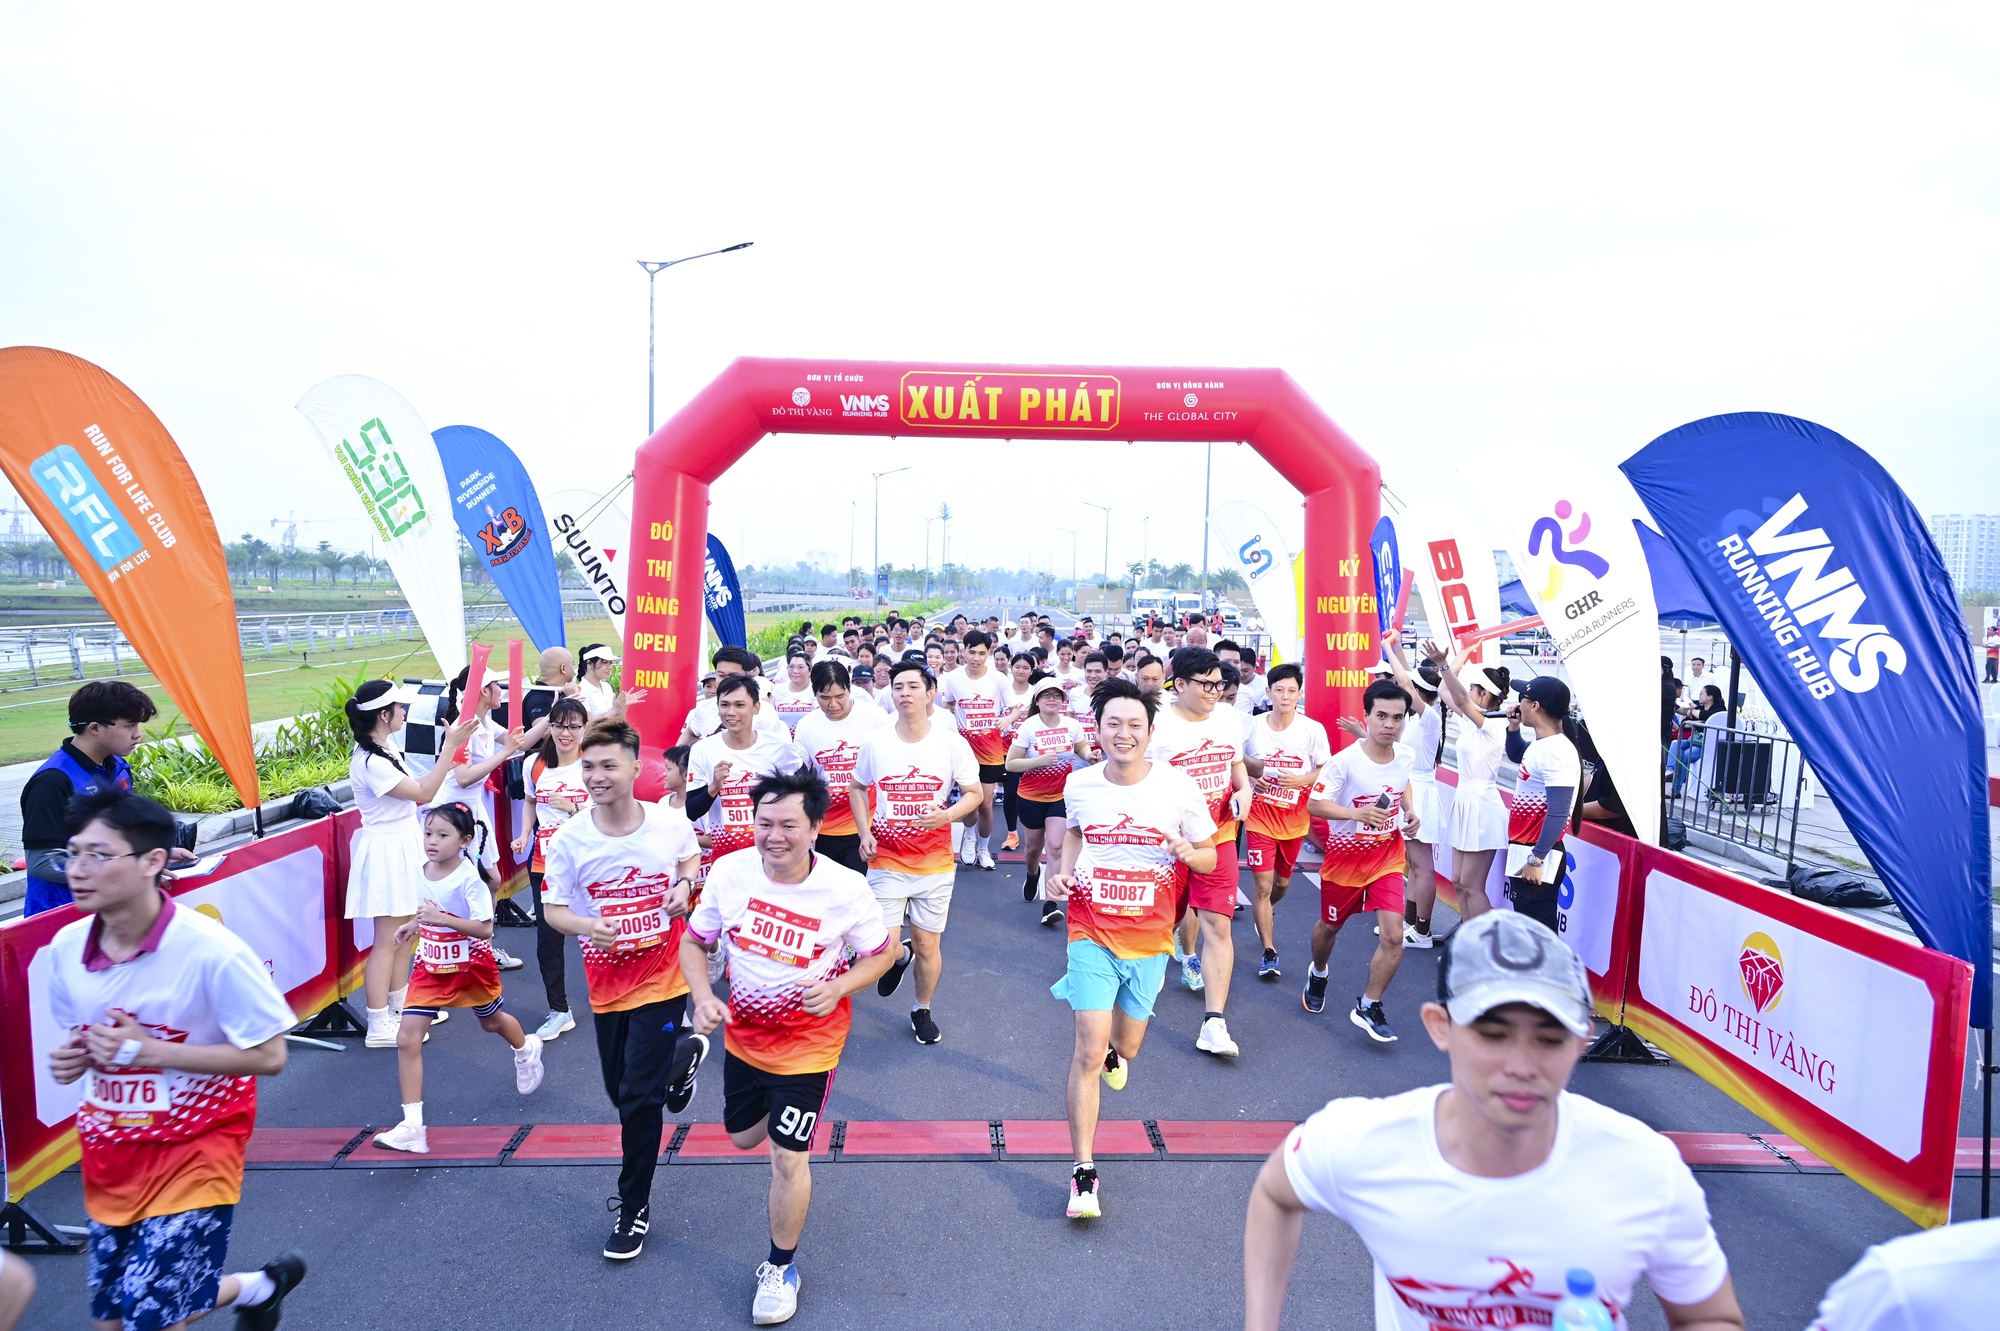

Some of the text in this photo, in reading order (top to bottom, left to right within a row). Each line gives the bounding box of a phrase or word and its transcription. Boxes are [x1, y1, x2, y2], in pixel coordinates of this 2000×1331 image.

[840, 395, 890, 411] VNMS
[907, 376, 1114, 422] XUẤT PHÁT
[772, 406, 832, 417] ĐÔ THỊ VÀNG
[1143, 411, 1238, 421] THE GLOBAL CITY
[83, 423, 177, 548] RUN FOR LIFE CLUB
[456, 471, 496, 505] RIVERSIDE
[459, 469, 482, 489] PARK
[465, 483, 498, 510] RUNNER
[42, 460, 120, 558] RFL
[650, 520, 674, 541] ĐÔ
[120, 562, 135, 574] FOR
[135, 549, 151, 565] LIFE
[553, 513, 626, 616] SUUNTO
[647, 559, 673, 581] THỊ
[1339, 553, 1361, 577] KỶ
[637, 592, 679, 616] VÀNG
[1317, 592, 1377, 614] NGUYÊN
[1747, 492, 1907, 694] VNMS
[1565, 590, 1604, 620] GHR
[1571, 625, 1593, 642] HOA
[1591, 597, 1636, 631] RUNNERS
[1716, 533, 1802, 647] RUNNING
[1787, 645, 1836, 701] HUB
[634, 632, 677, 653] OPEN
[1326, 632, 1370, 651] VƯƠN
[635, 669, 669, 689] RUN
[1325, 666, 1369, 687] MÌNH
[1041, 735, 1067, 746] 50093
[893, 803, 928, 816] 50082
[1248, 849, 1263, 866] 63
[1100, 883, 1147, 901] 50087
[1328, 905, 1338, 921] 9
[751, 916, 805, 950] 50101
[423, 942, 461, 960] 50019
[1688, 984, 1836, 1095] ĐÔ THỊ VÀNG
[776, 1105, 817, 1142] 90
